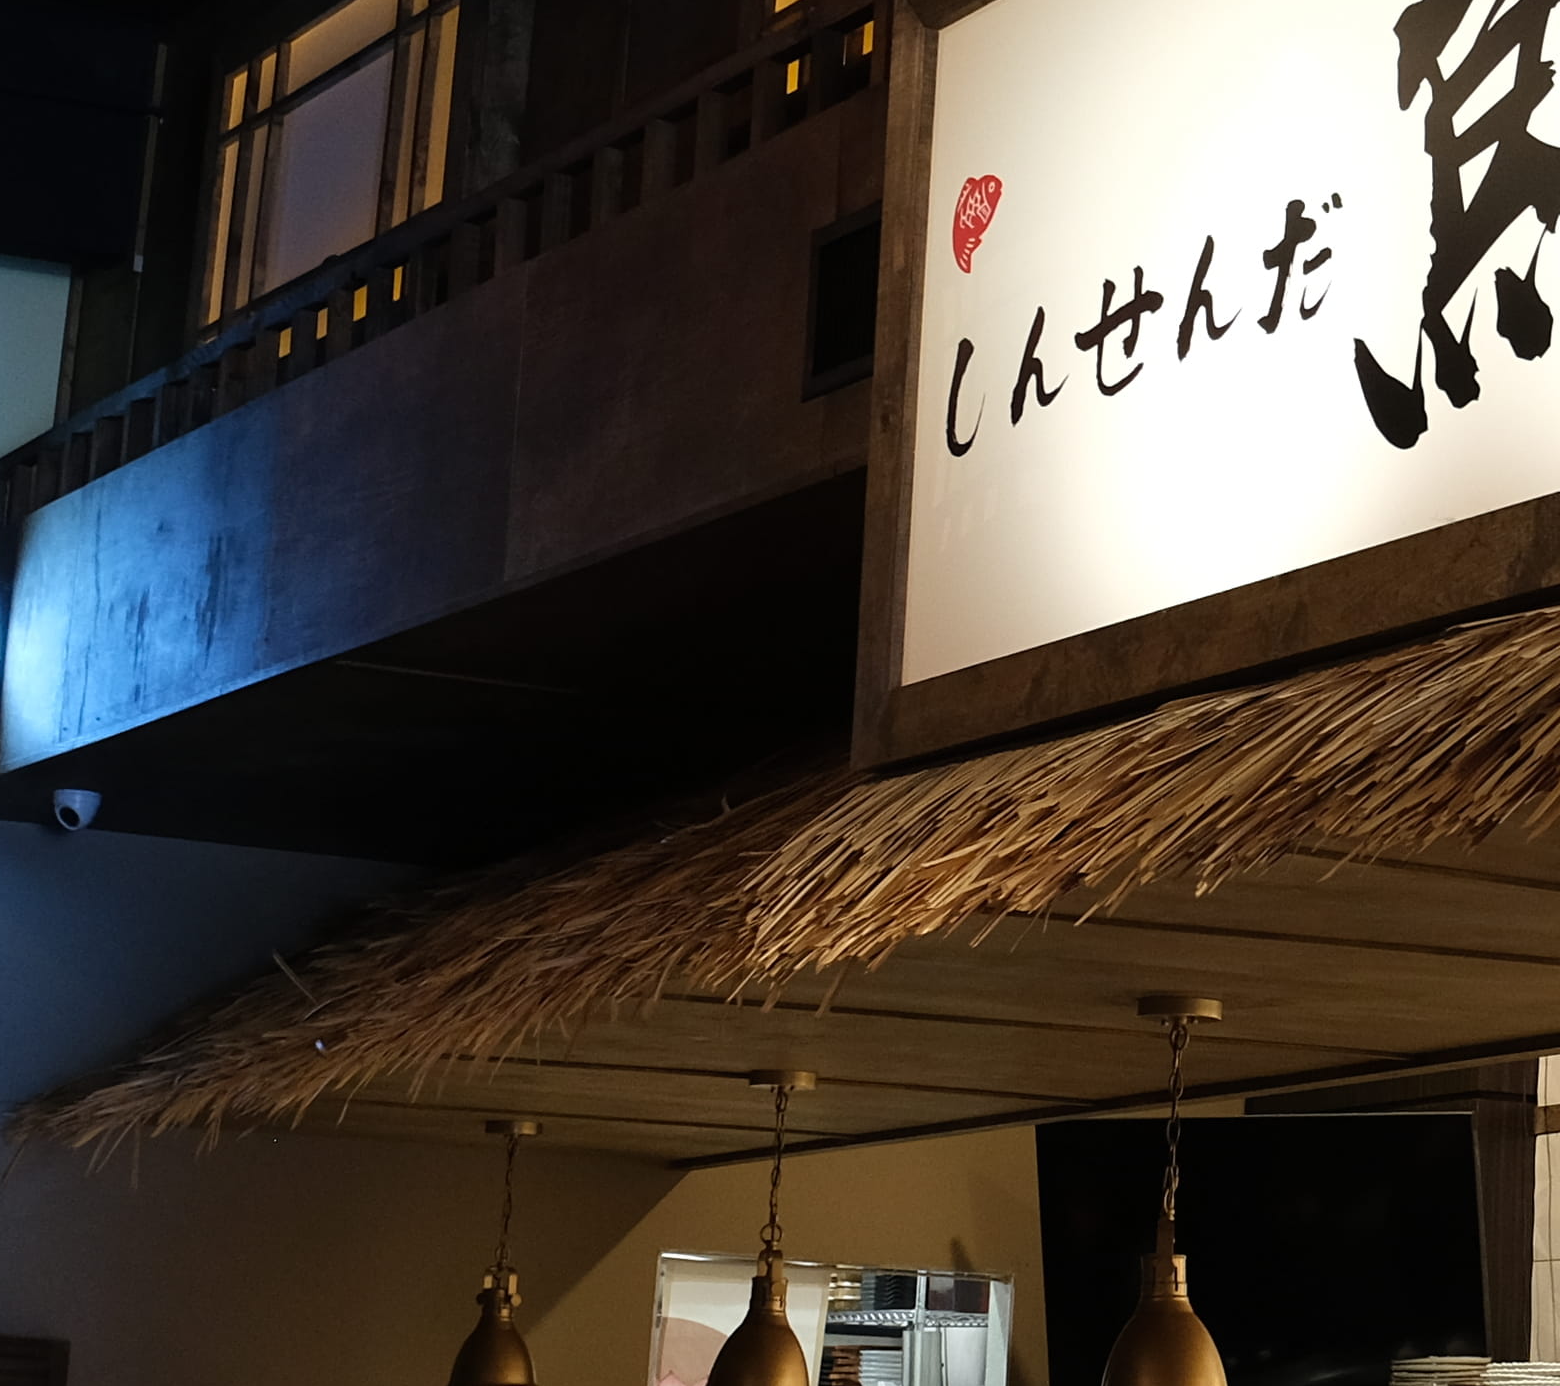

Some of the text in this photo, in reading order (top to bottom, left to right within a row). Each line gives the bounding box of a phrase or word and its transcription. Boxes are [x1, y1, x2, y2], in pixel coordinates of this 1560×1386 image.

[946, 193, 1343, 457] しんせんだ
